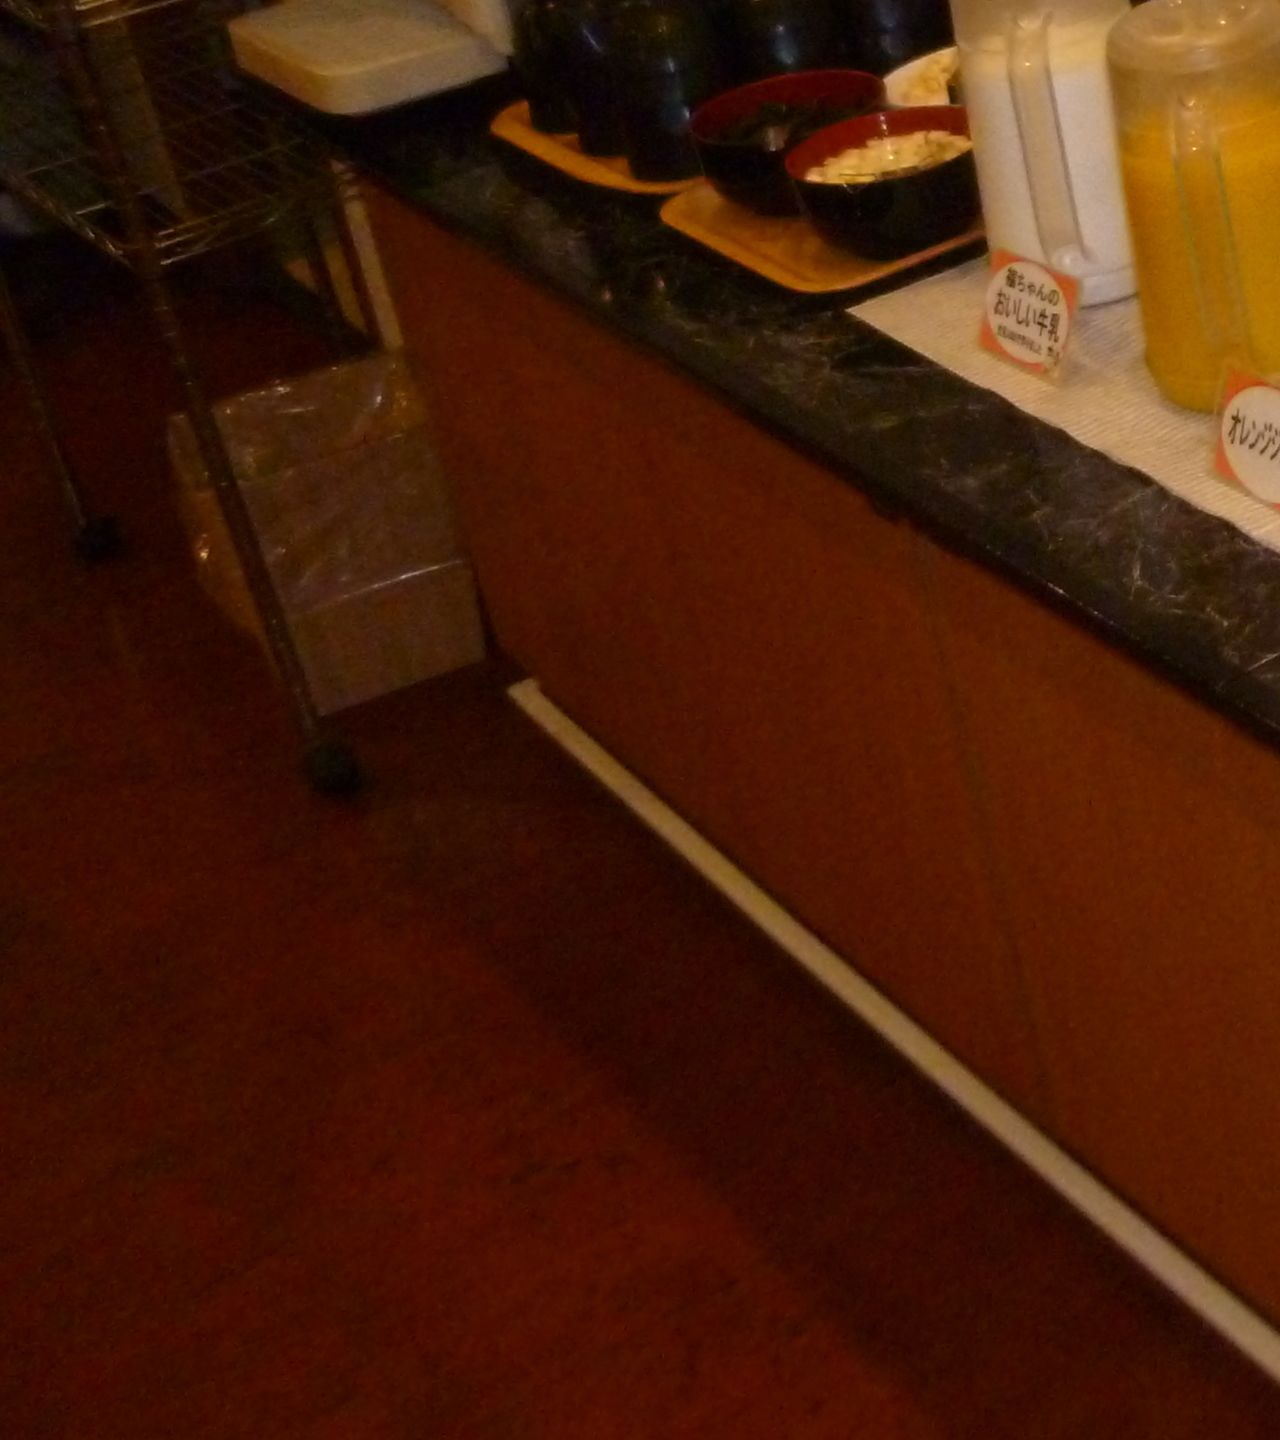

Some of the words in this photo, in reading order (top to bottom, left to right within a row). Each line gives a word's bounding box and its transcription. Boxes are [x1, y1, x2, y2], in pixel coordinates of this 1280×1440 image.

[993, 289, 1060, 343] おいしい牛乳
